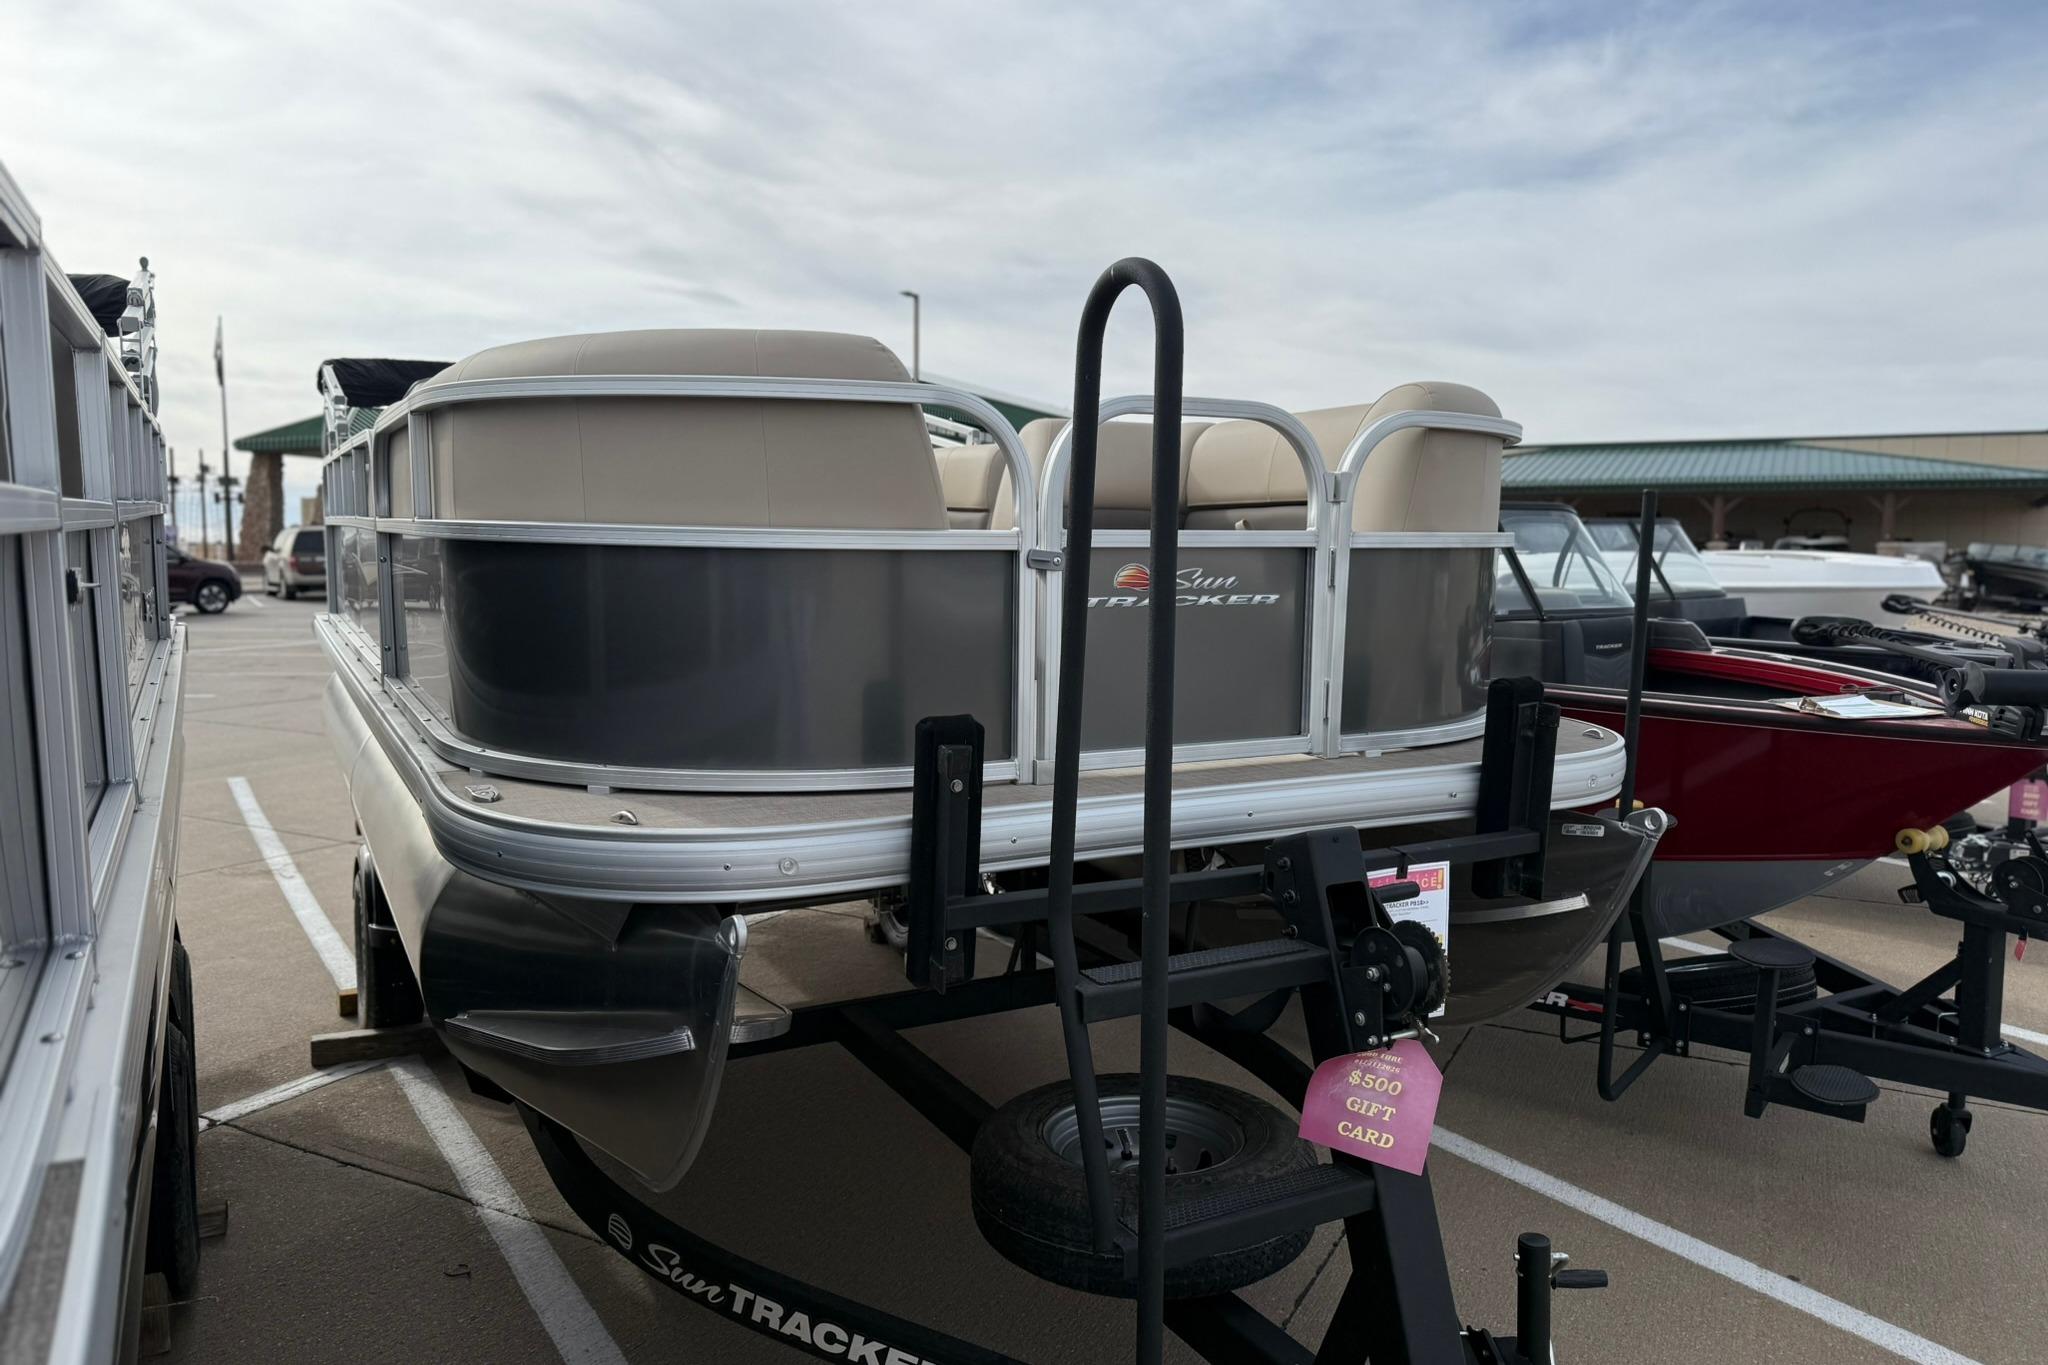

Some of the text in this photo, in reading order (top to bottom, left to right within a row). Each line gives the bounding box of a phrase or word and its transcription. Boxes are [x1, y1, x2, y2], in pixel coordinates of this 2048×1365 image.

[1175, 567, 1240, 590] Sun
[1348, 1069, 1403, 1096] $500
[1345, 1096, 1397, 1122] GIFT
[1337, 1121, 1395, 1149] CARD
[639, 1243, 725, 1304] Sun
